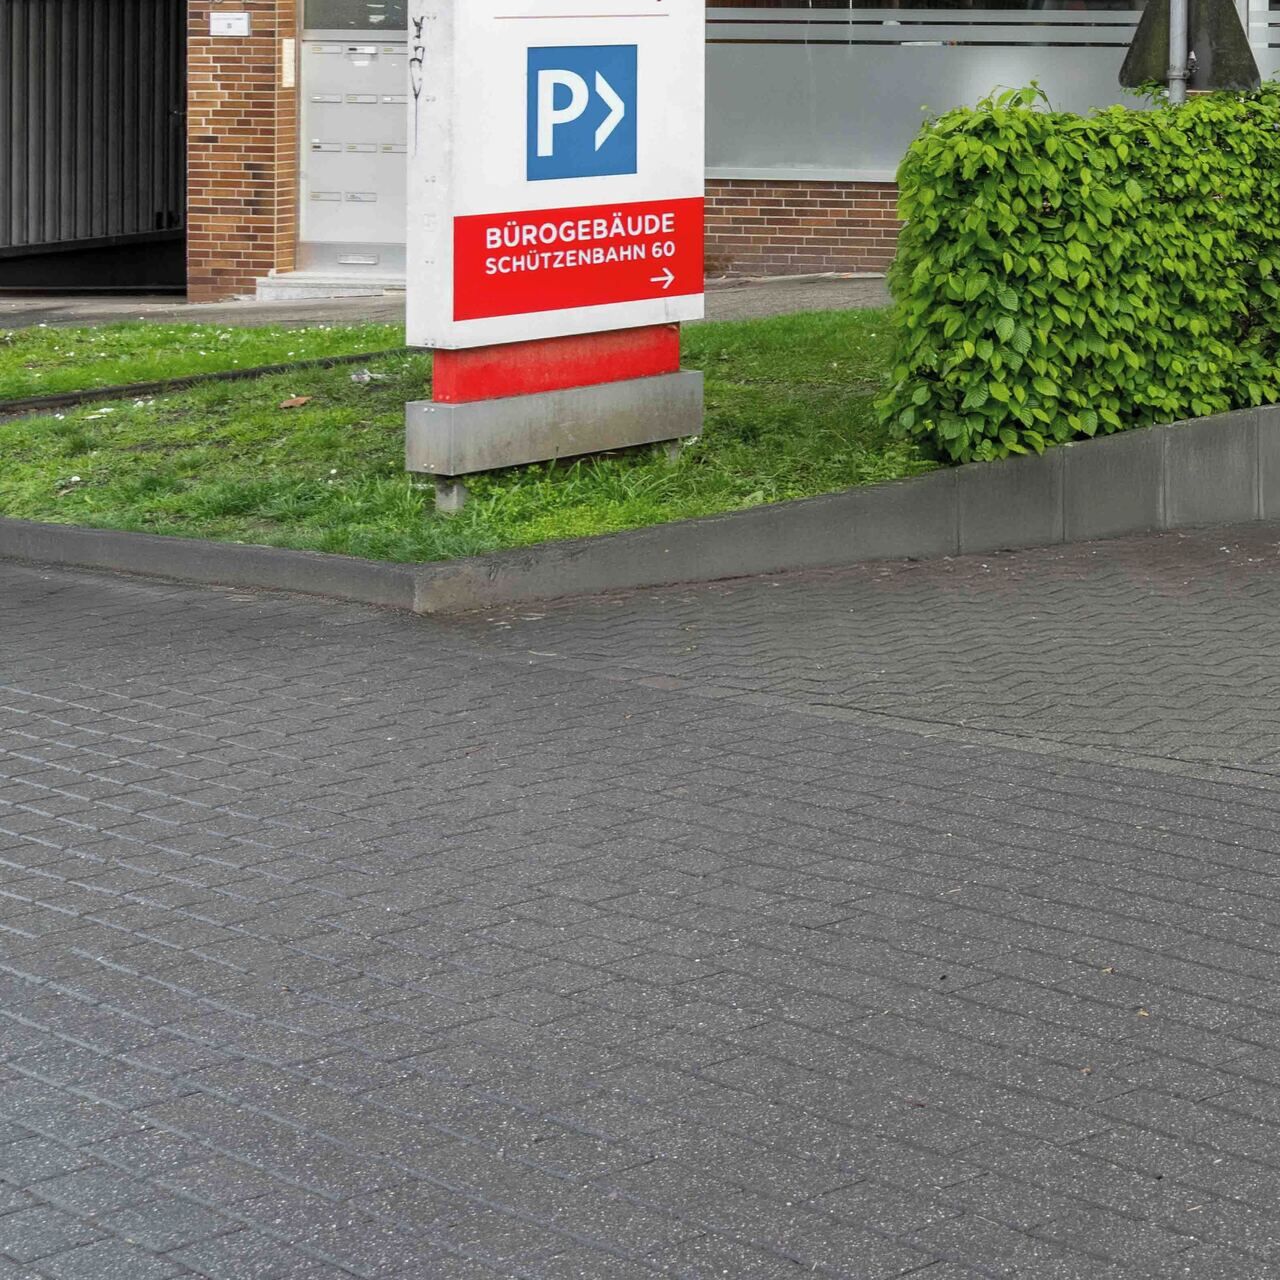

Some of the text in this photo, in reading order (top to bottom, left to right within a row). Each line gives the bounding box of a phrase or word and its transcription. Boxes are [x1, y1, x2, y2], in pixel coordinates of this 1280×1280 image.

[486, 212, 675, 249] BÜROGEBÄUDE
[485, 240, 676, 275] SCHÜTZENBAHN 60
